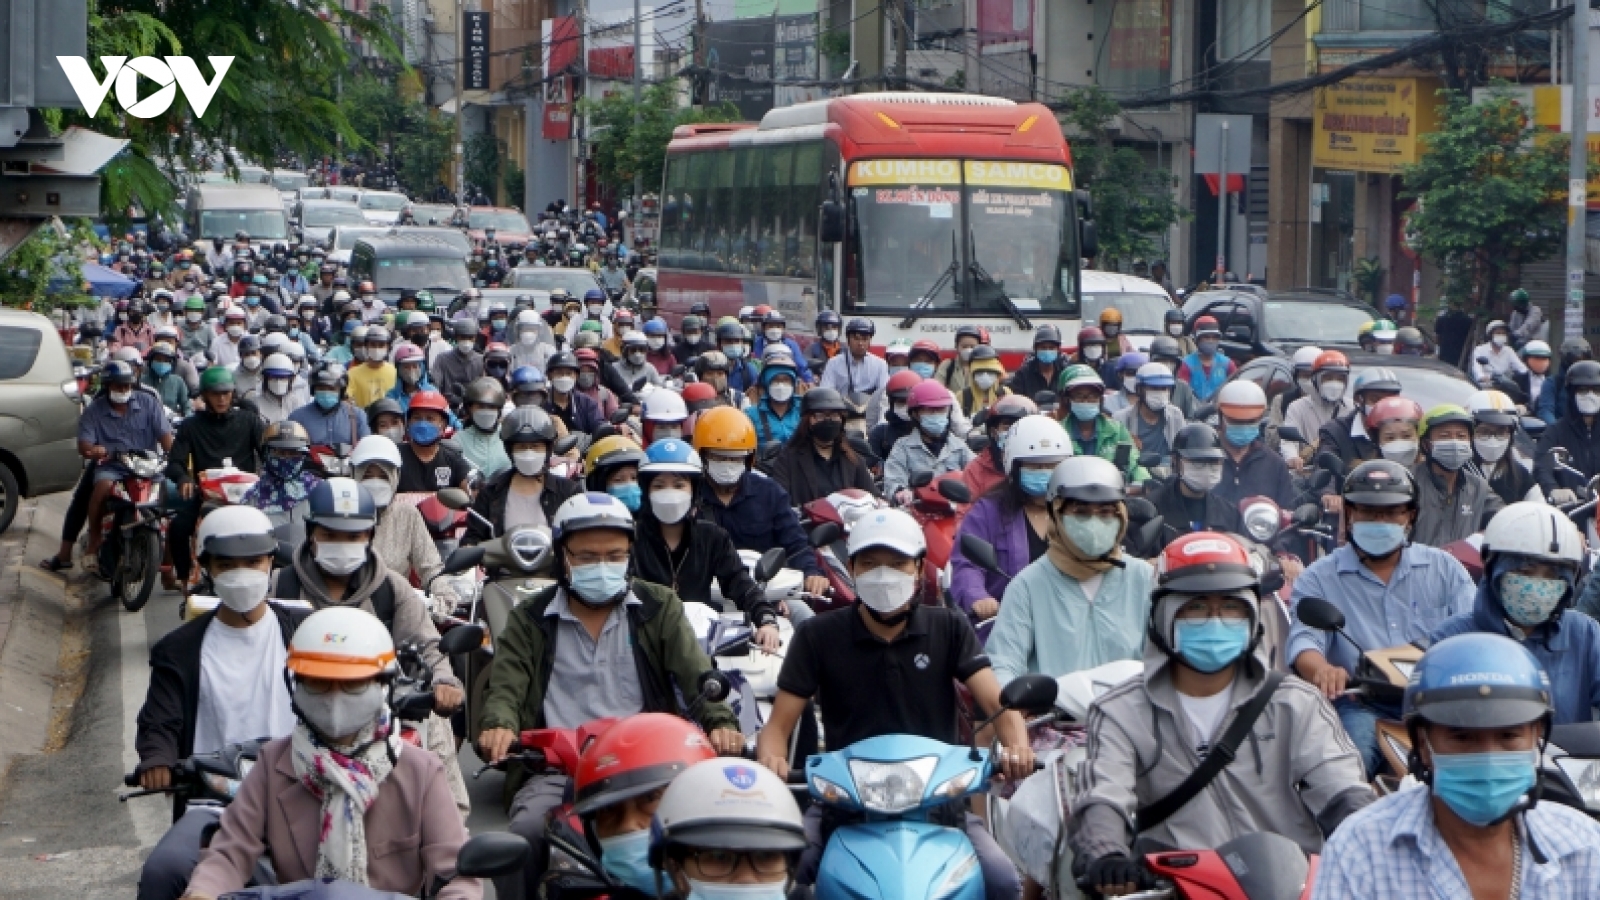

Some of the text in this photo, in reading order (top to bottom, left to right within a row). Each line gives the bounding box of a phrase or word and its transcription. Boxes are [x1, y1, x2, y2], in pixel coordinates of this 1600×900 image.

[857, 160, 955, 177] KUMHO
[971, 161, 1062, 182] SAMCO
[1450, 672, 1515, 685] HONDA
